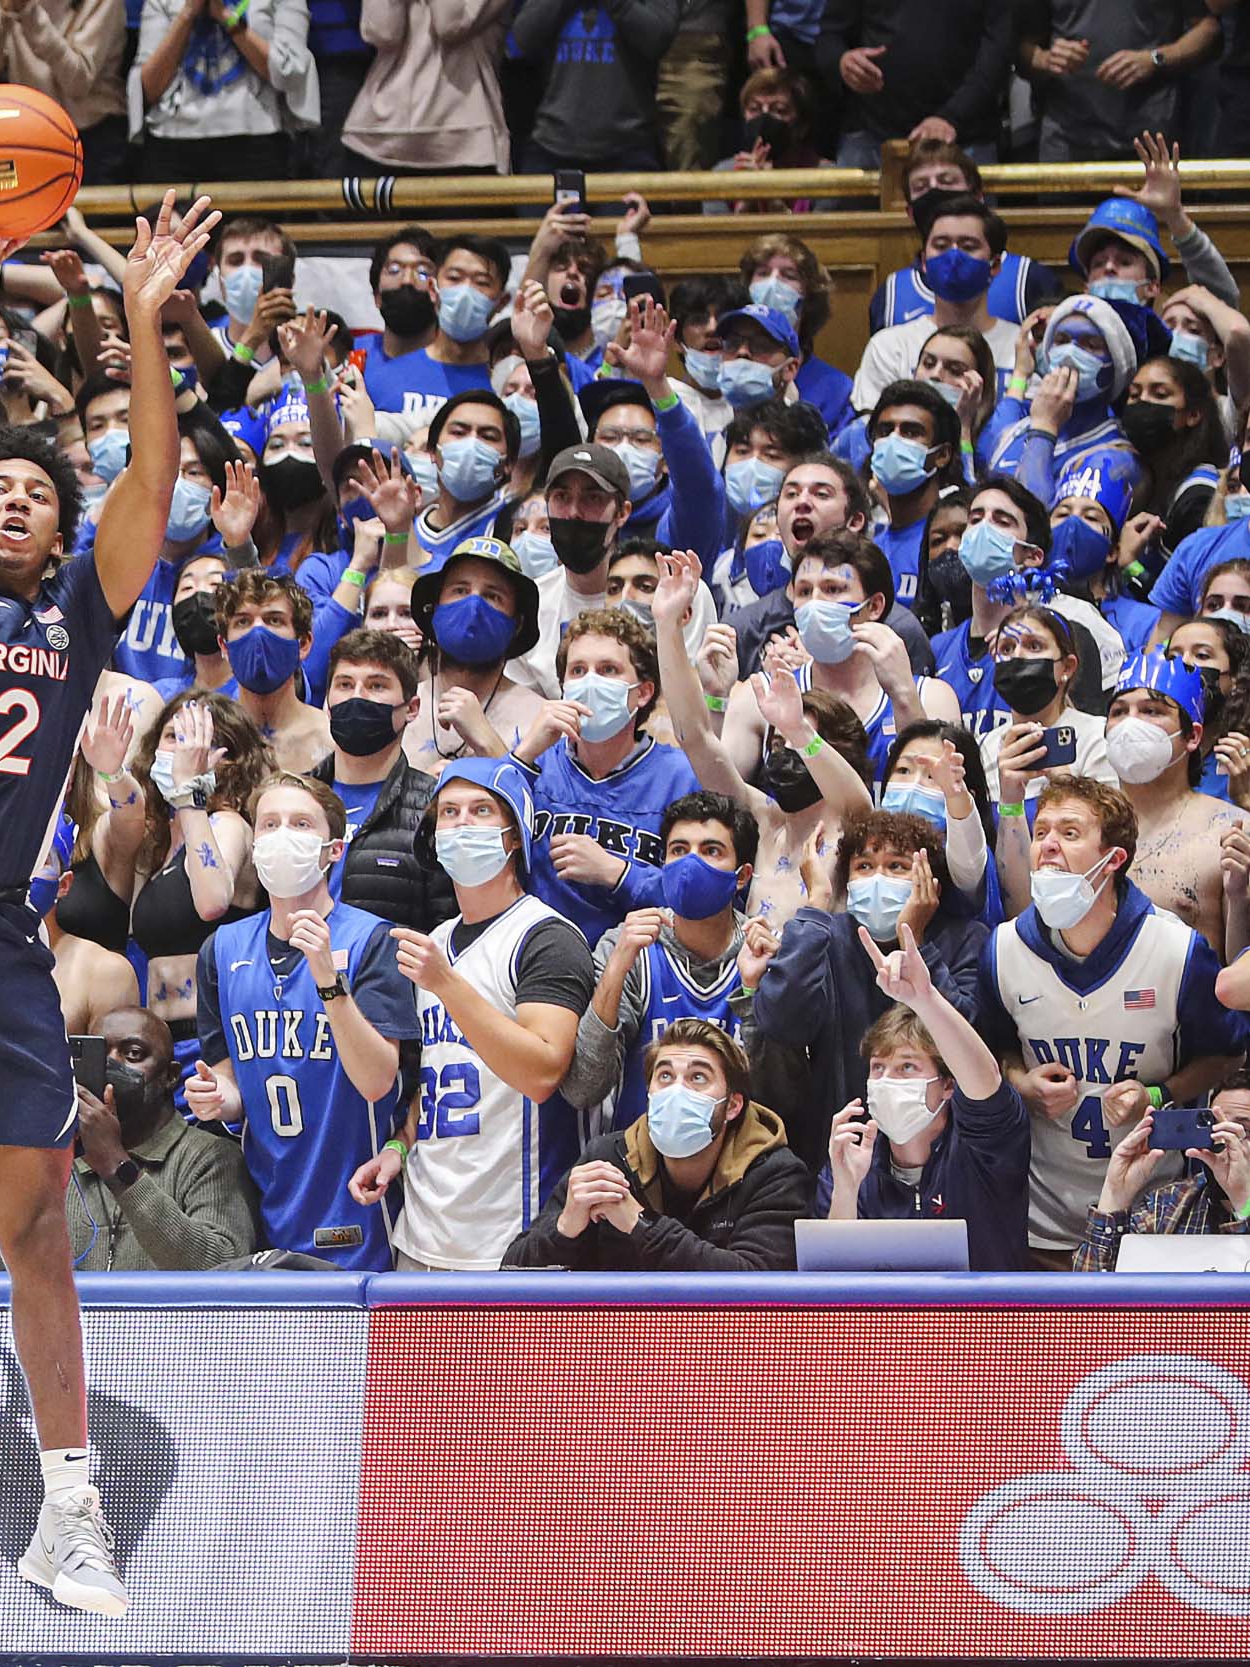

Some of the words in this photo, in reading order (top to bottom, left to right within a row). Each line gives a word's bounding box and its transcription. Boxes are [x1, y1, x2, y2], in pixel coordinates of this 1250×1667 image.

[556, 41, 615, 64] DUKE
[229, 1009, 333, 1062] DUKE
[1028, 1037, 1146, 1085] DUKE
[265, 1074, 304, 1138] 0
[416, 1062, 481, 1140] 32
[1070, 1095, 1112, 1159] 4
